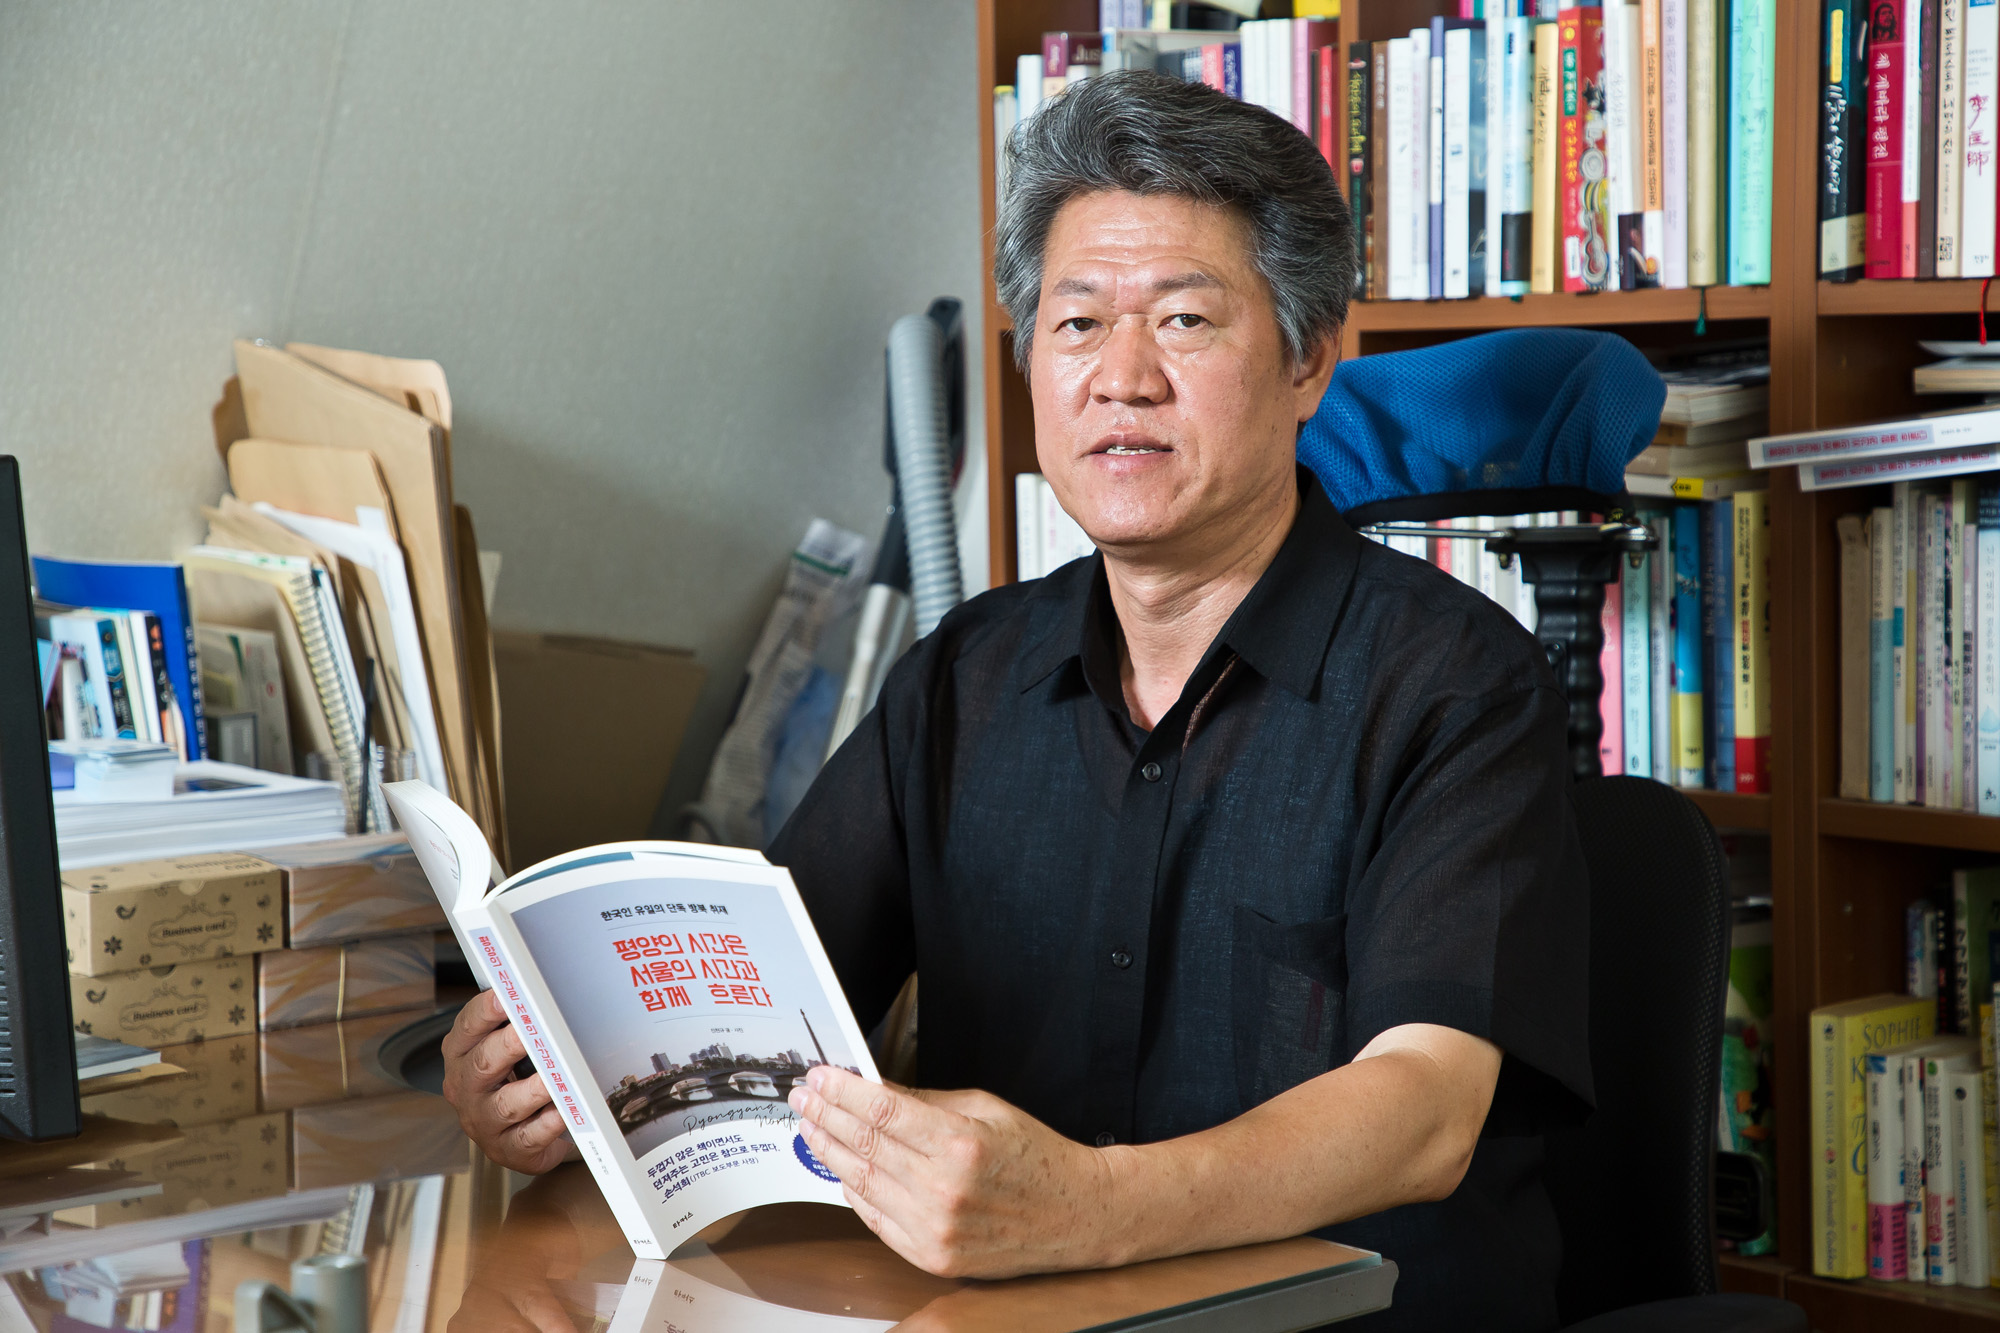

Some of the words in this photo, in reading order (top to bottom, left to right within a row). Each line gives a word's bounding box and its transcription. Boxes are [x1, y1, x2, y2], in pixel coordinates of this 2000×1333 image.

[600, 907, 633, 922] 한국인
[634, 904, 666, 919] 유일의
[667, 903, 686, 916] 단독
[688, 903, 707, 916] 방북
[709, 904, 729, 916] 취재
[162, 923, 204, 938] Business
[205, 920, 228, 933] card
[612, 933, 684, 962] 평양의
[688, 932, 750, 957] 시간은
[629, 957, 697, 988] 서울의
[702, 958, 761, 983] 시간과
[132, 1008, 175, 1022] Business
[176, 1004, 199, 1016] card
[637, 986, 692, 1013] 함께
[711, 983, 774, 1009] 흐른다
[478, 936, 502, 968] 평양의
[498, 969, 520, 1001] 시간은
[516, 1003, 538, 1036] 서울의
[534, 1038, 556, 1069] 시간과
[550, 1072, 569, 1093] 함께
[563, 1095, 585, 1126] 흐른다
[1863, 1015, 1922, 1052] SOPHIE
[683, 1101, 779, 1136] Pyongyang,
[754, 1111, 798, 1131] North
[647, 1156, 675, 1178] 두껍지
[675, 1146, 695, 1161] 않은
[696, 1134, 744, 1151] 책이면서도
[653, 1165, 690, 1191] 던져주는
[691, 1152, 719, 1169] 고민은
[721, 1145, 750, 1158] 참으로
[750, 1142, 781, 1153] 두껍다.
[712, 1160, 740, 1173] 보도부문
[741, 1157, 759, 1165] 사장)
